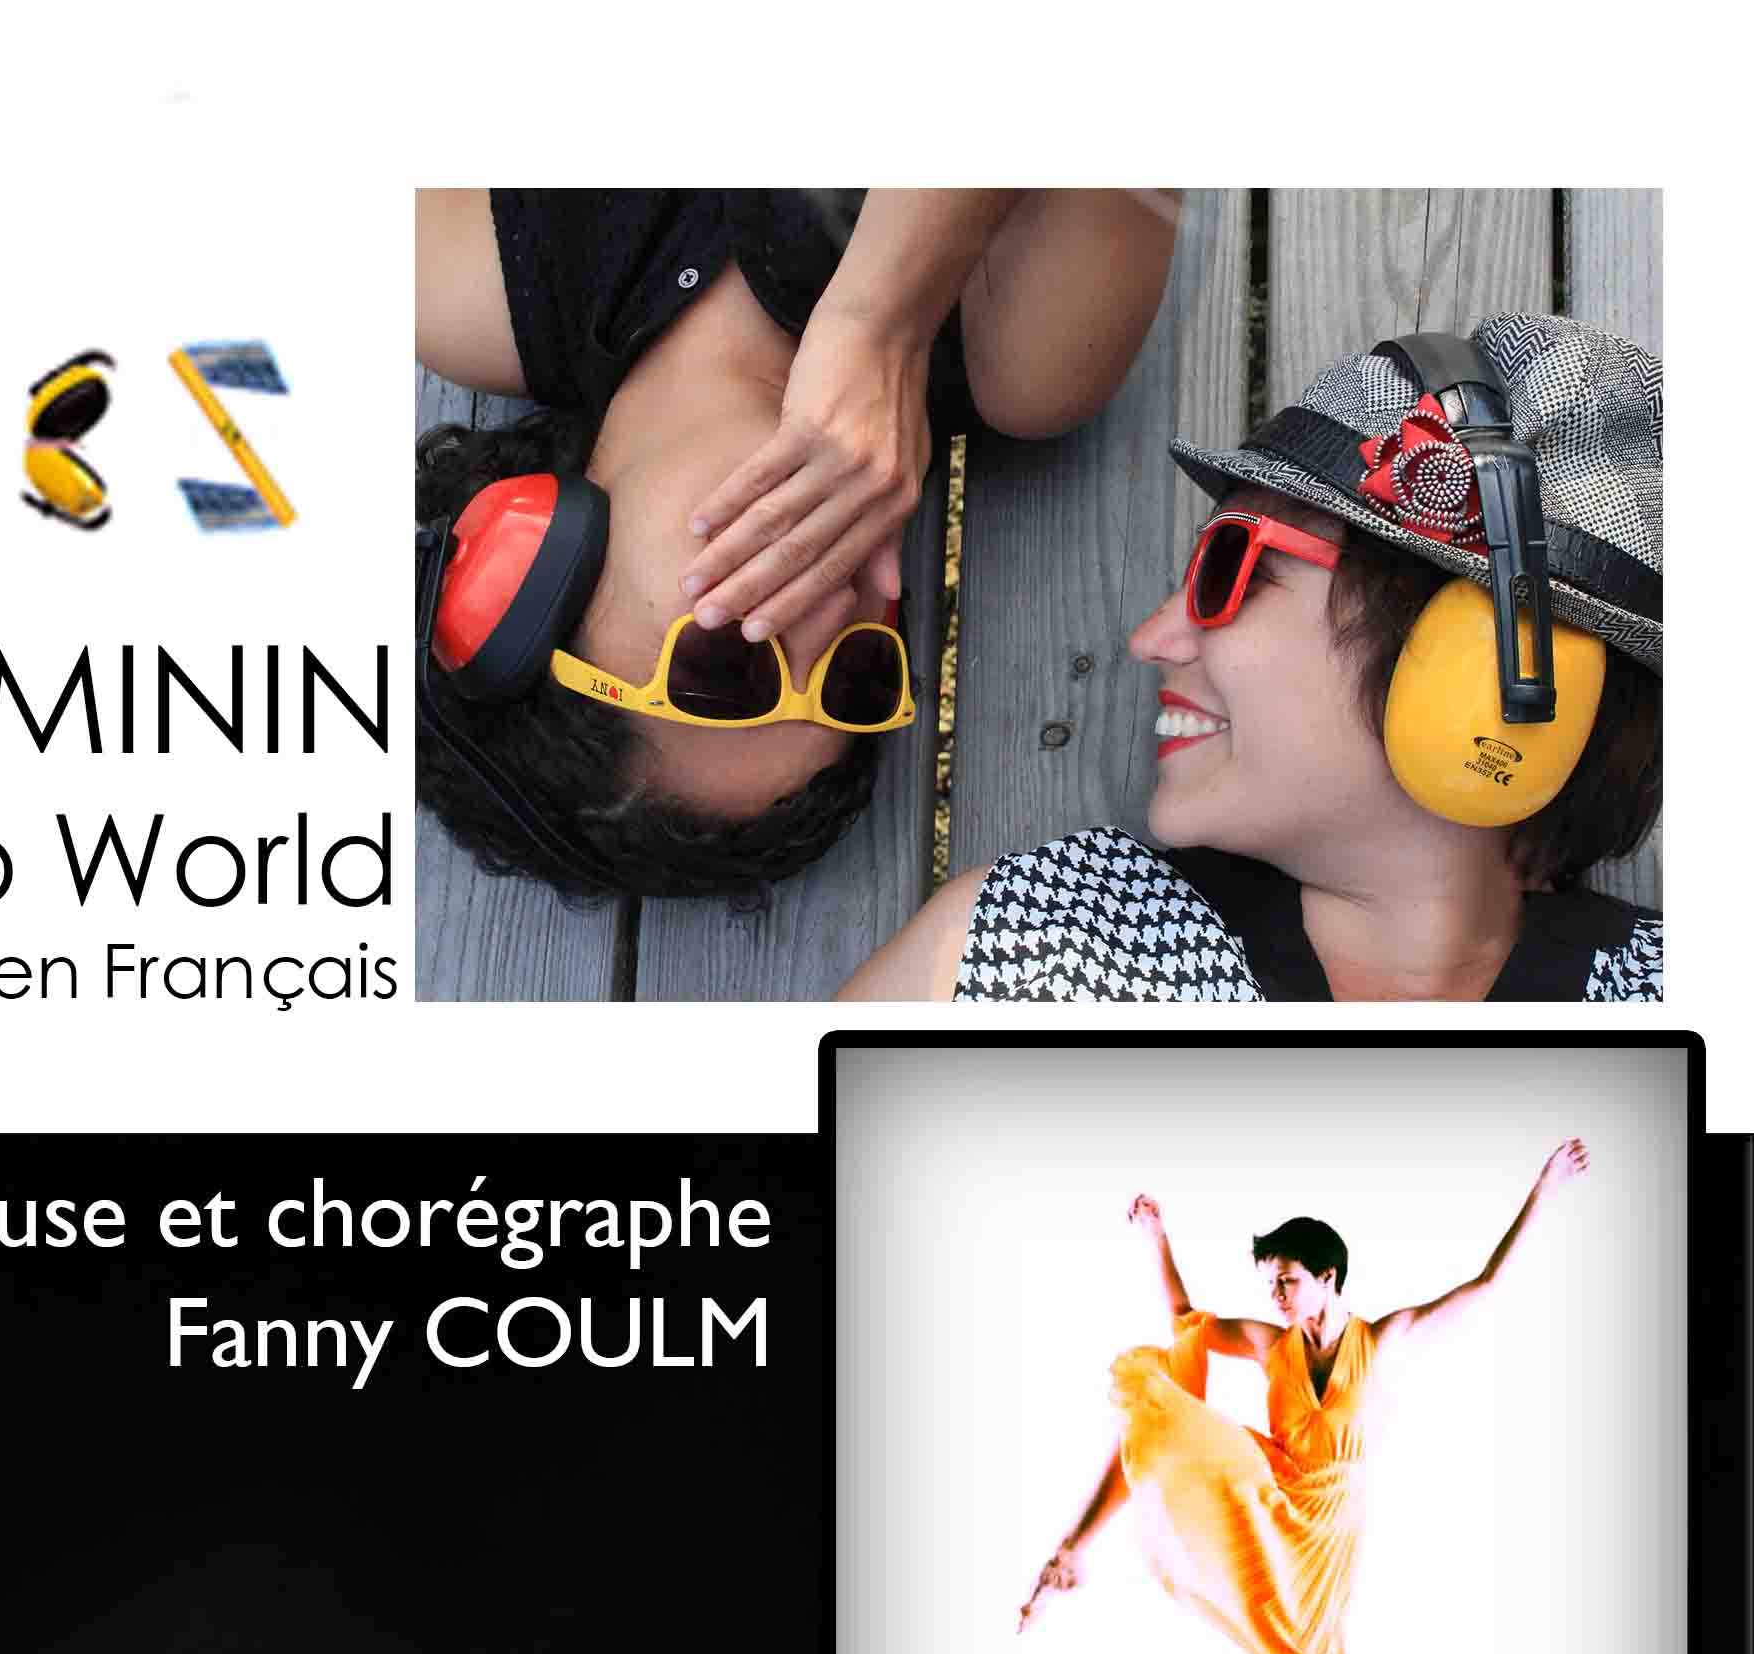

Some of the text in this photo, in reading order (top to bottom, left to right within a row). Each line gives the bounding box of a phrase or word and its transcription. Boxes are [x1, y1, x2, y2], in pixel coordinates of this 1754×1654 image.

[56, 813, 393, 907] World
[108, 943, 399, 1012] Français
[159, 1191, 238, 1248] et
[268, 1176, 771, 1270] chorégraphe
[169, 1296, 767, 1390] Fanny COULM
